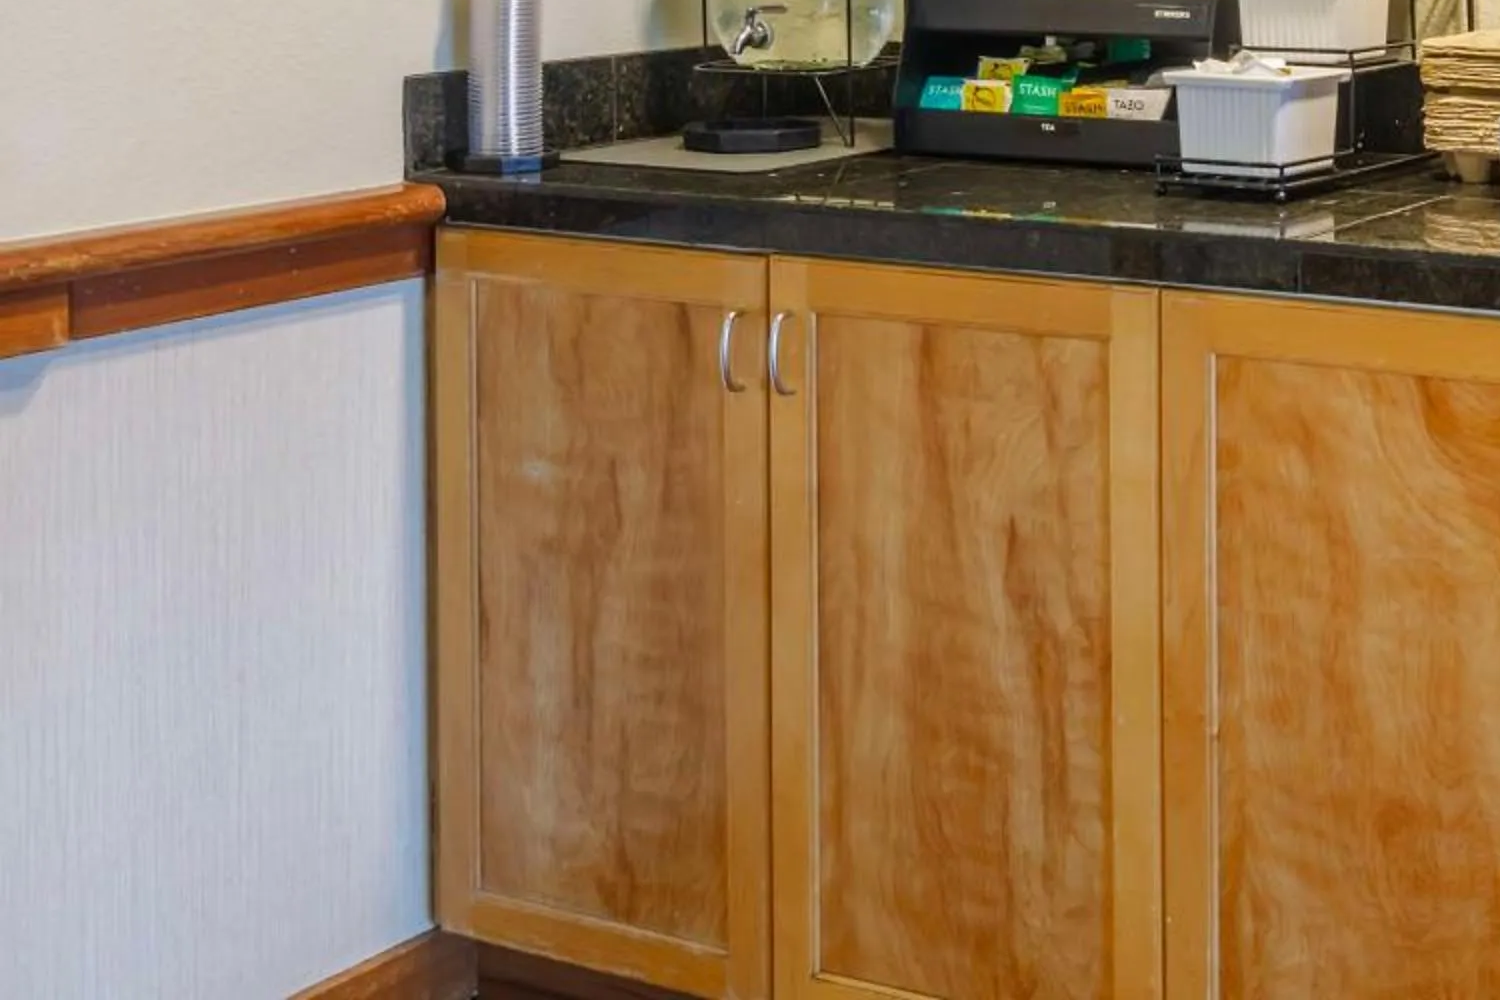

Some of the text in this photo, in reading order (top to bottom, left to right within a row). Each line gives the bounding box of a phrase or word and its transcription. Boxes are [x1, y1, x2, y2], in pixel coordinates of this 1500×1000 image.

[1019, 82, 1057, 98] STASH
[1114, 99, 1145, 112] TAZO
[1041, 122, 1056, 132] TEA
